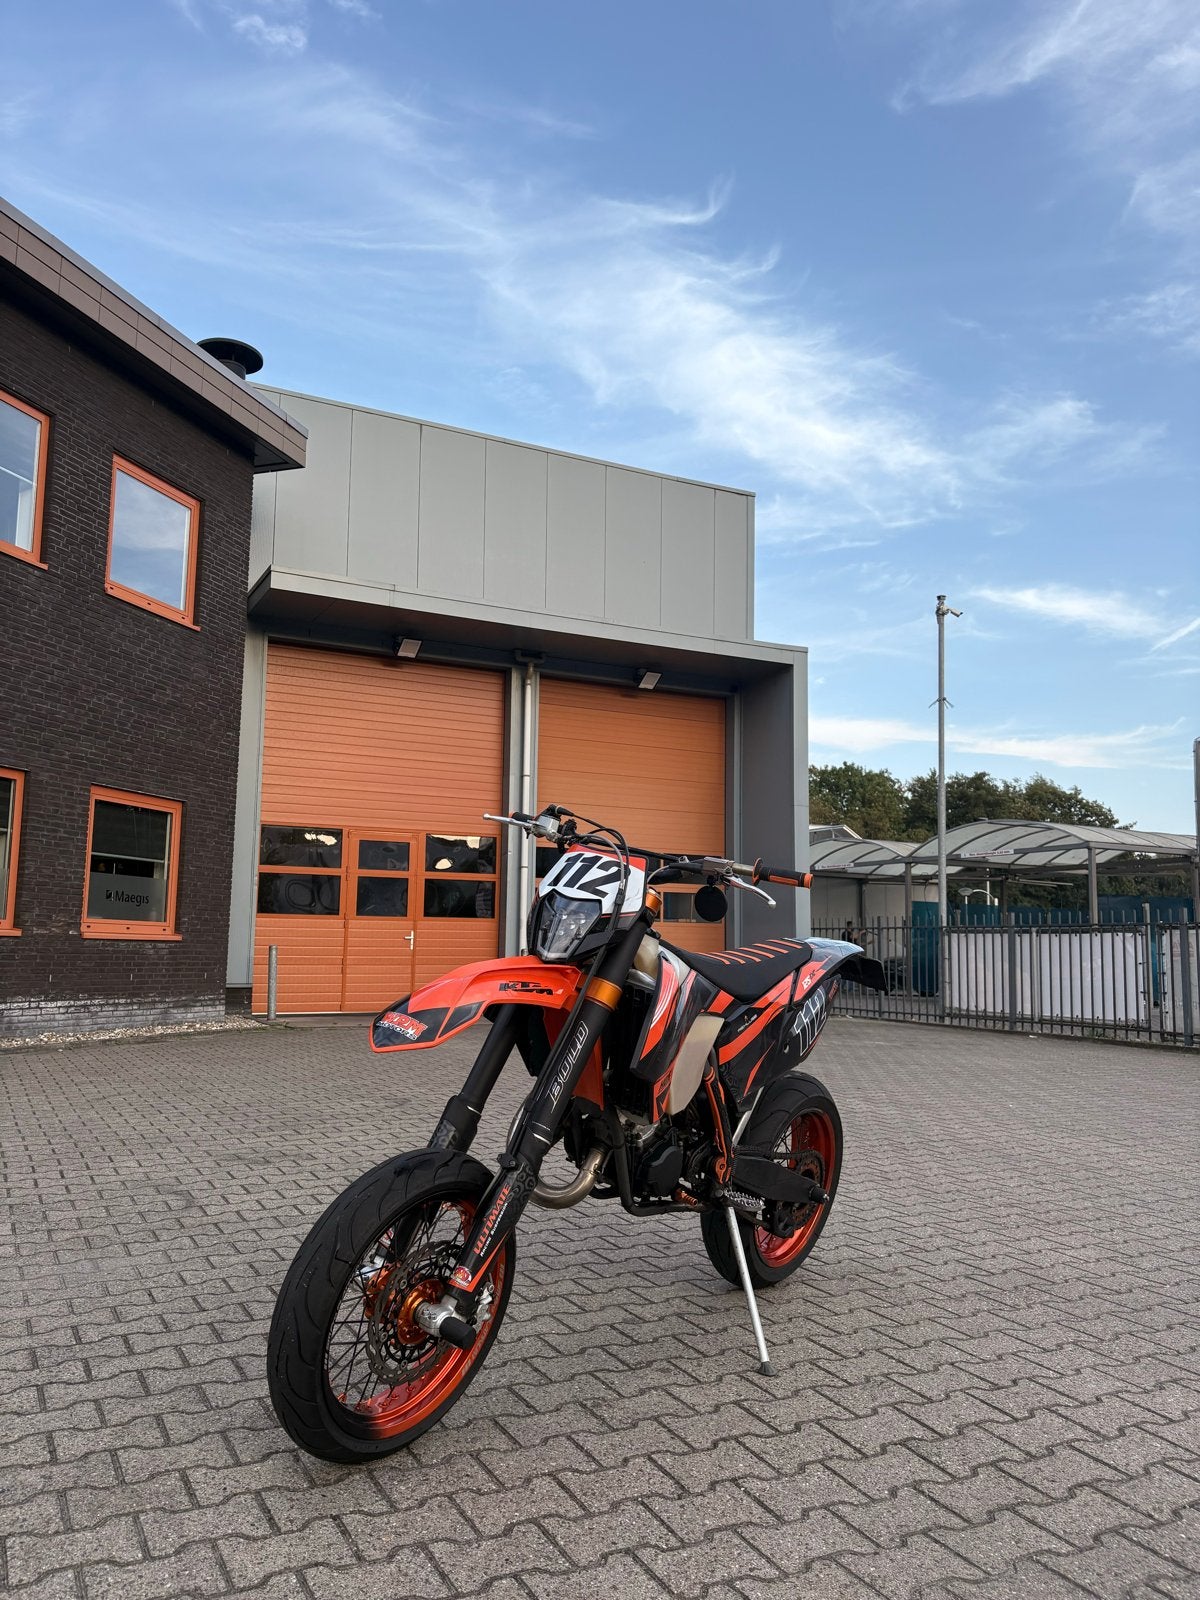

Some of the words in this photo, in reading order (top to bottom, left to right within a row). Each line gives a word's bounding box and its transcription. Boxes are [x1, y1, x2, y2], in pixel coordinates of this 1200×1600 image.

[547, 853, 625, 899] 112
[115, 890, 150, 907] Maegis
[499, 980, 554, 995] KTM
[375, 1020, 418, 1041] MOTORS
[793, 988, 827, 1056] 112
